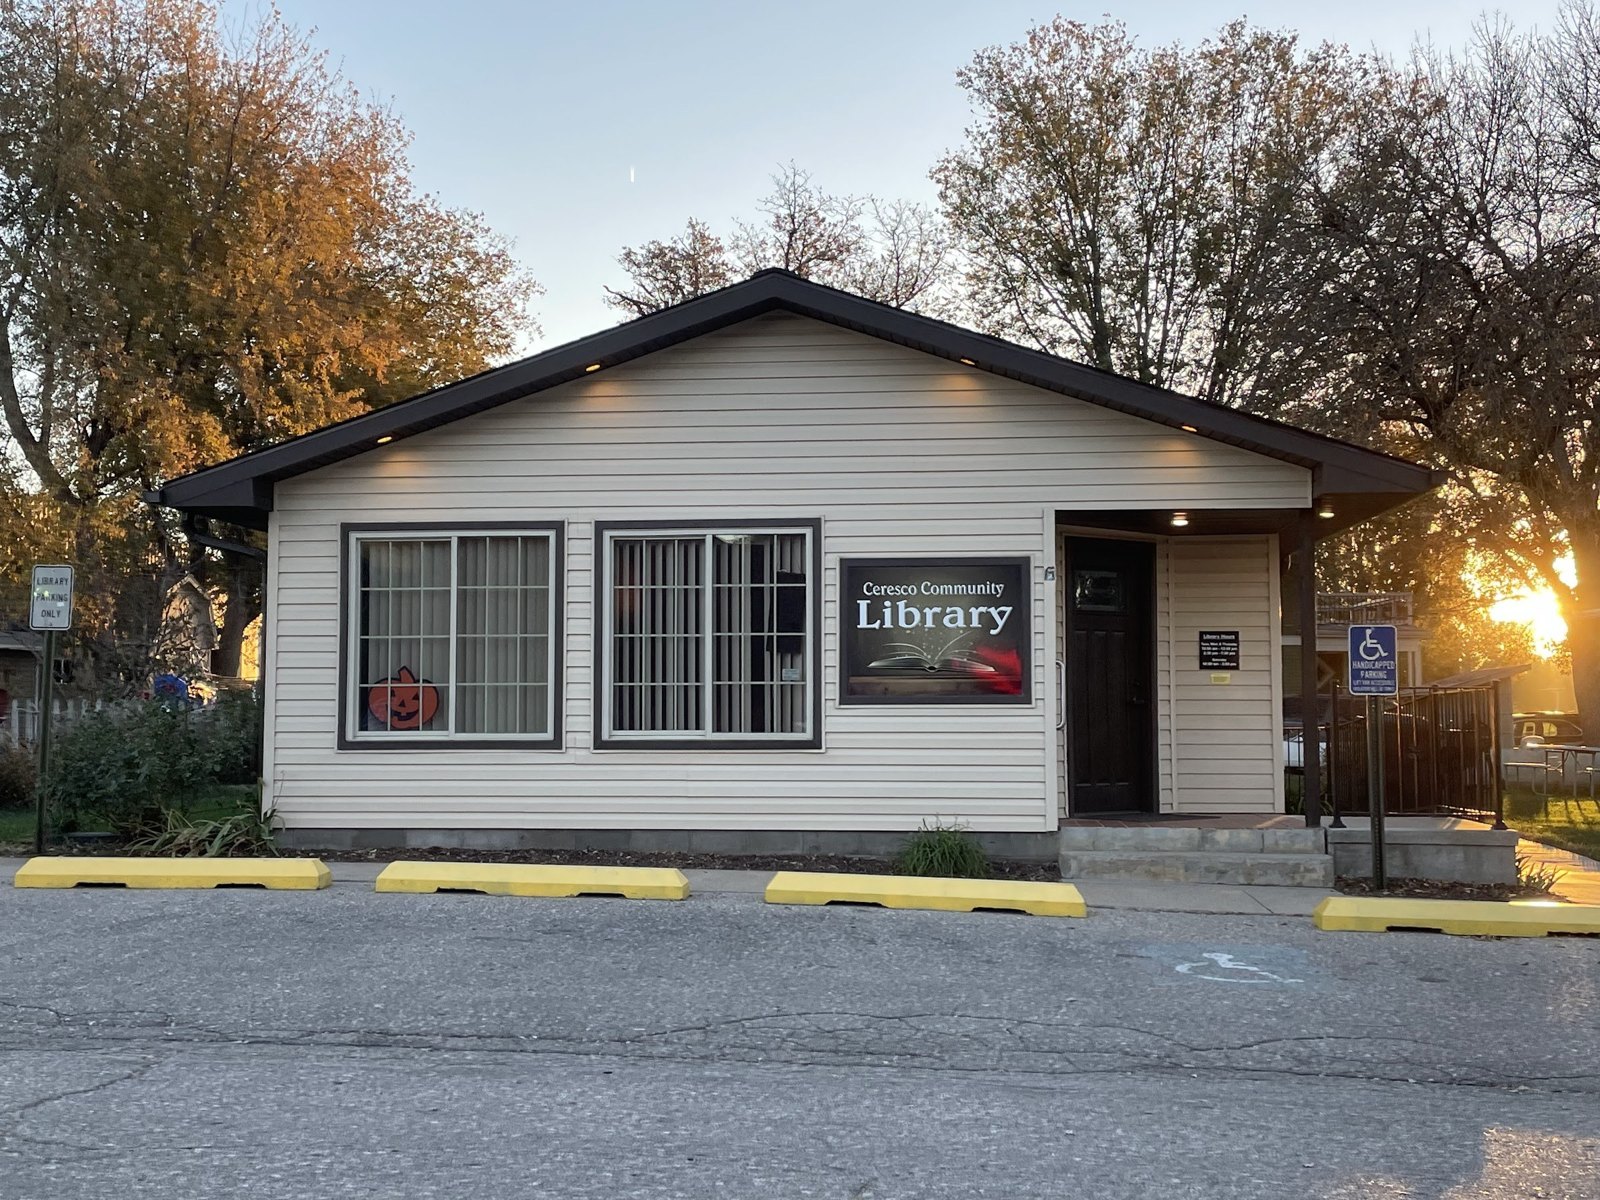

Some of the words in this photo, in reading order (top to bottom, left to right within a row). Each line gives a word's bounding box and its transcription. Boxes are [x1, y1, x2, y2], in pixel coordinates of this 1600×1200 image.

[36, 577, 69, 585] LIBRARY
[863, 581, 917, 596] Ceresco
[920, 581, 1004, 598] Community
[35, 593, 68, 602] PARKING
[41, 609, 61, 618] ONLY
[856, 599, 1014, 635] Library
[1352, 661, 1394, 669] HANDICAPPED
[1360, 670, 1387, 679] PARKING
